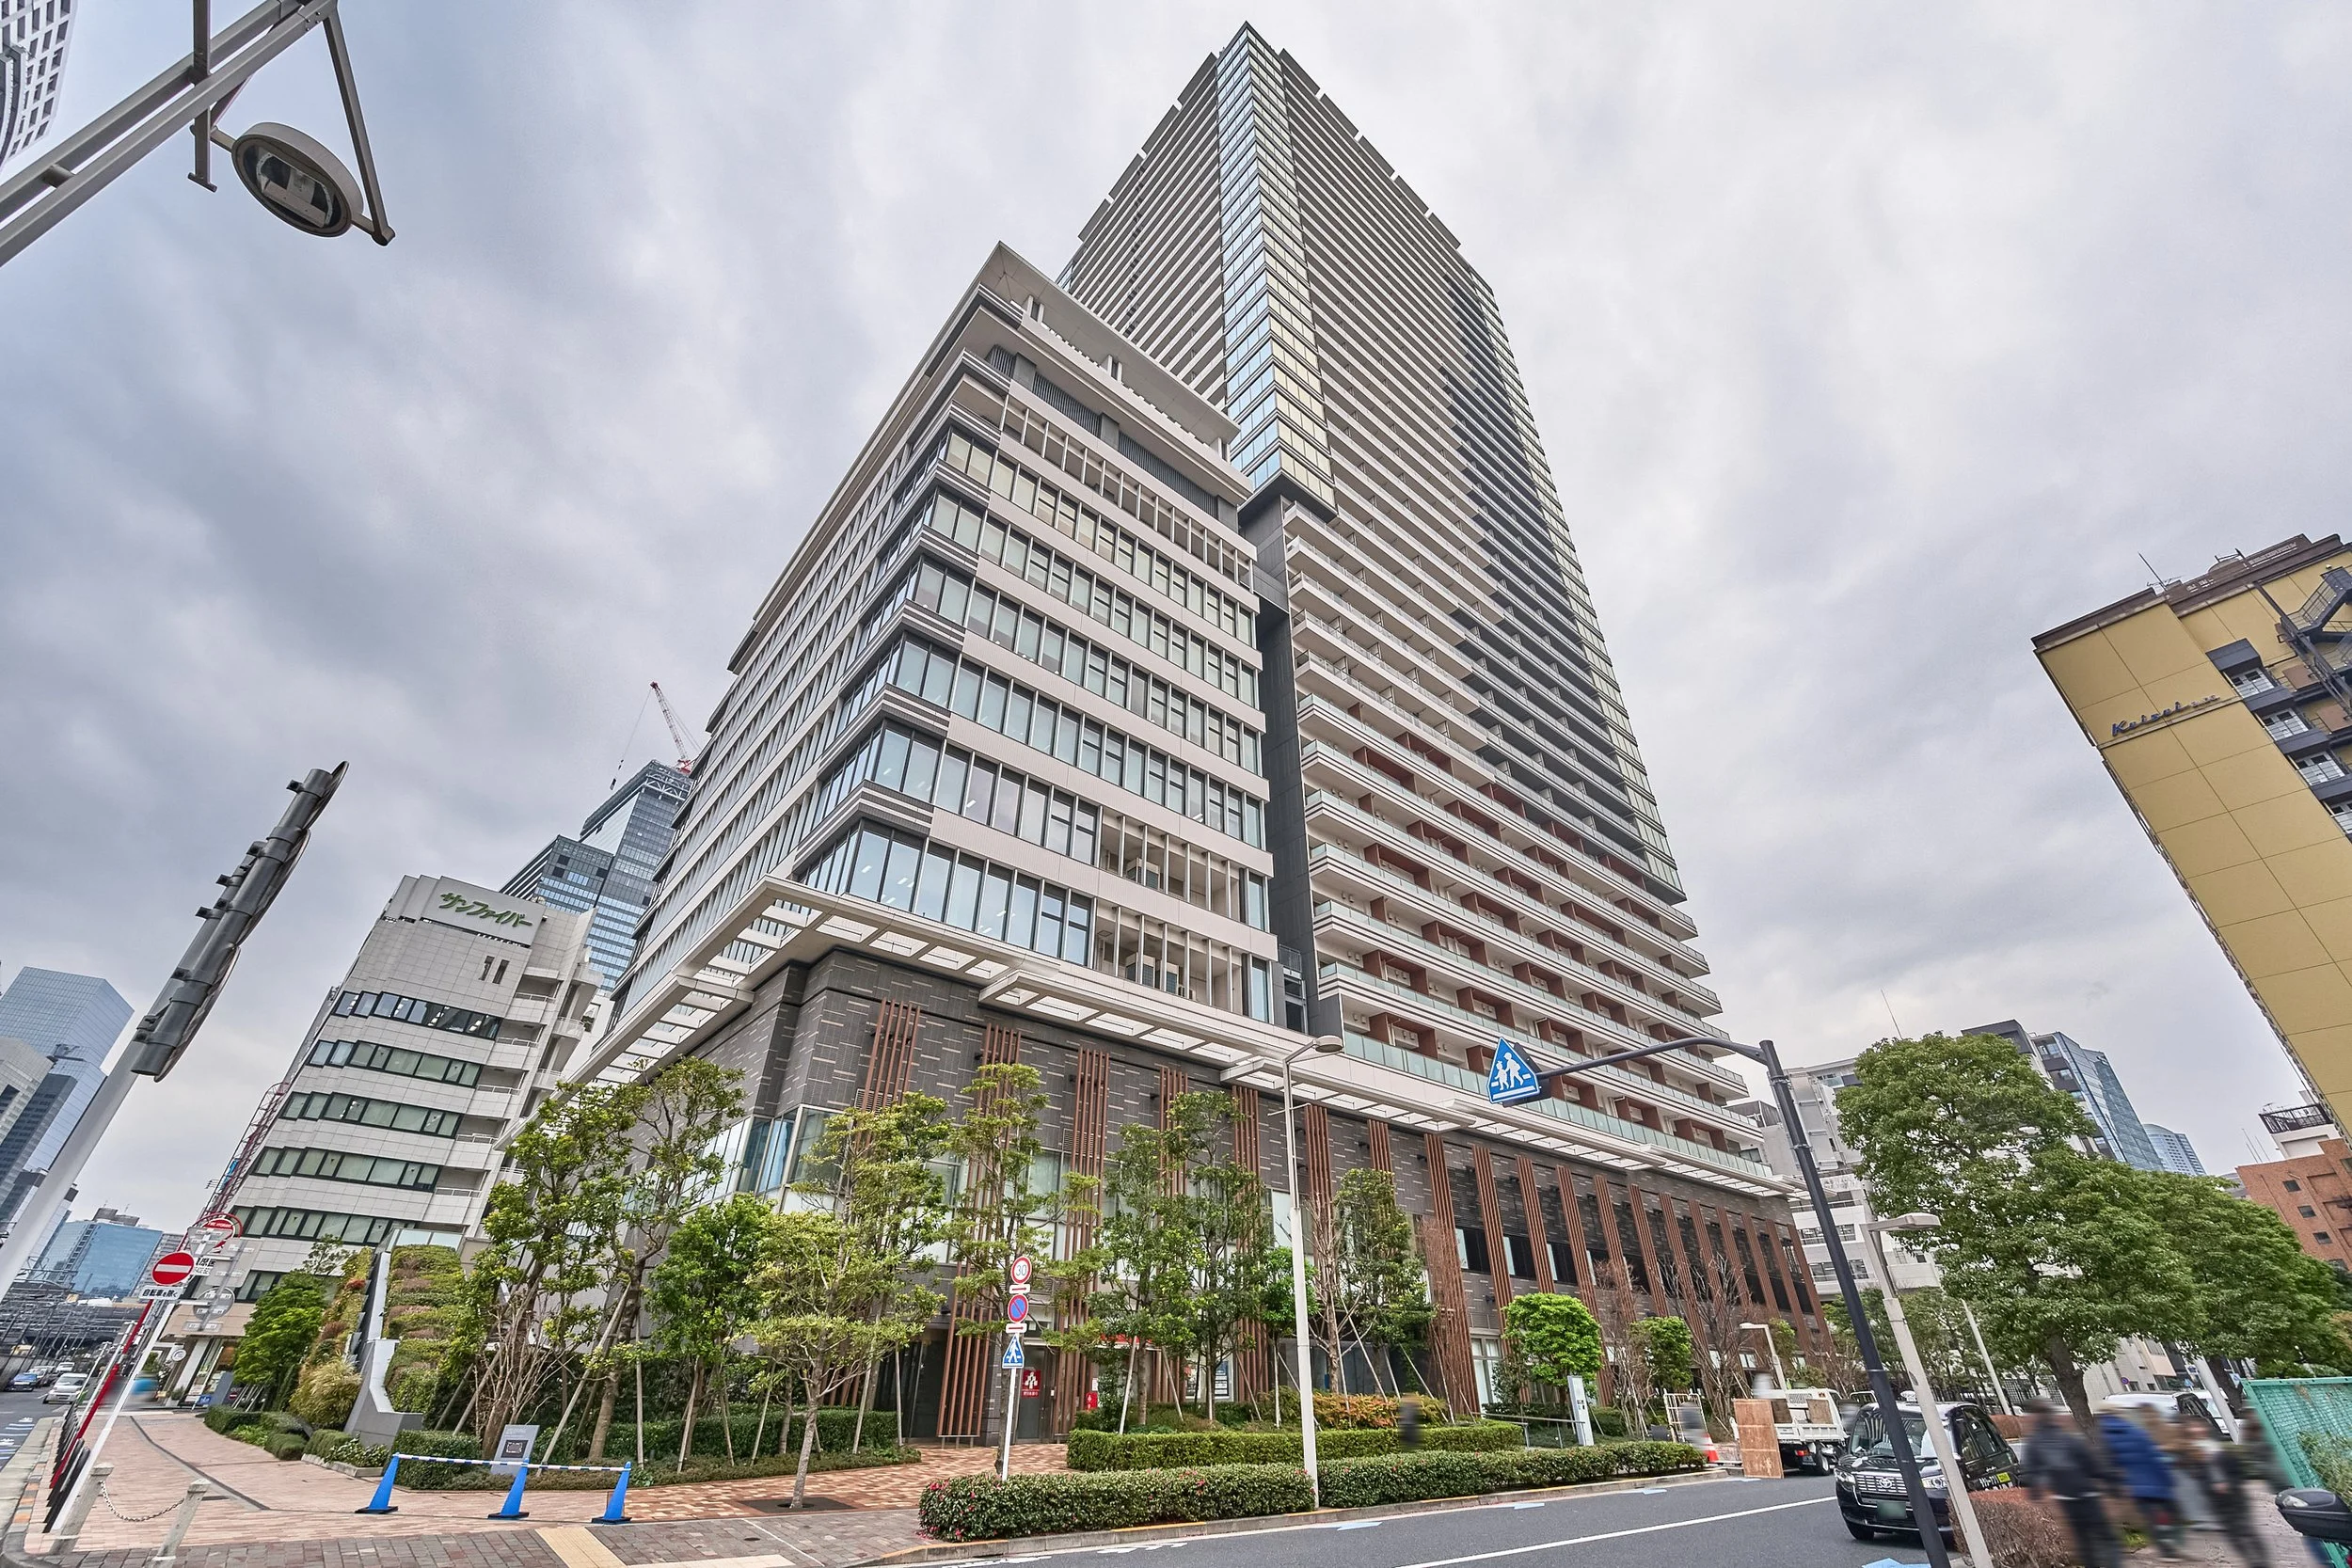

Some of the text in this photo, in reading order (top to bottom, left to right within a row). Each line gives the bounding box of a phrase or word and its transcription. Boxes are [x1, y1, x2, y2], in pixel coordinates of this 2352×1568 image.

[438, 893, 533, 927] サンファイバー
[1016, 1265, 1027, 1276] 30
[142, 1289, 178, 1297] 自転車を除く
